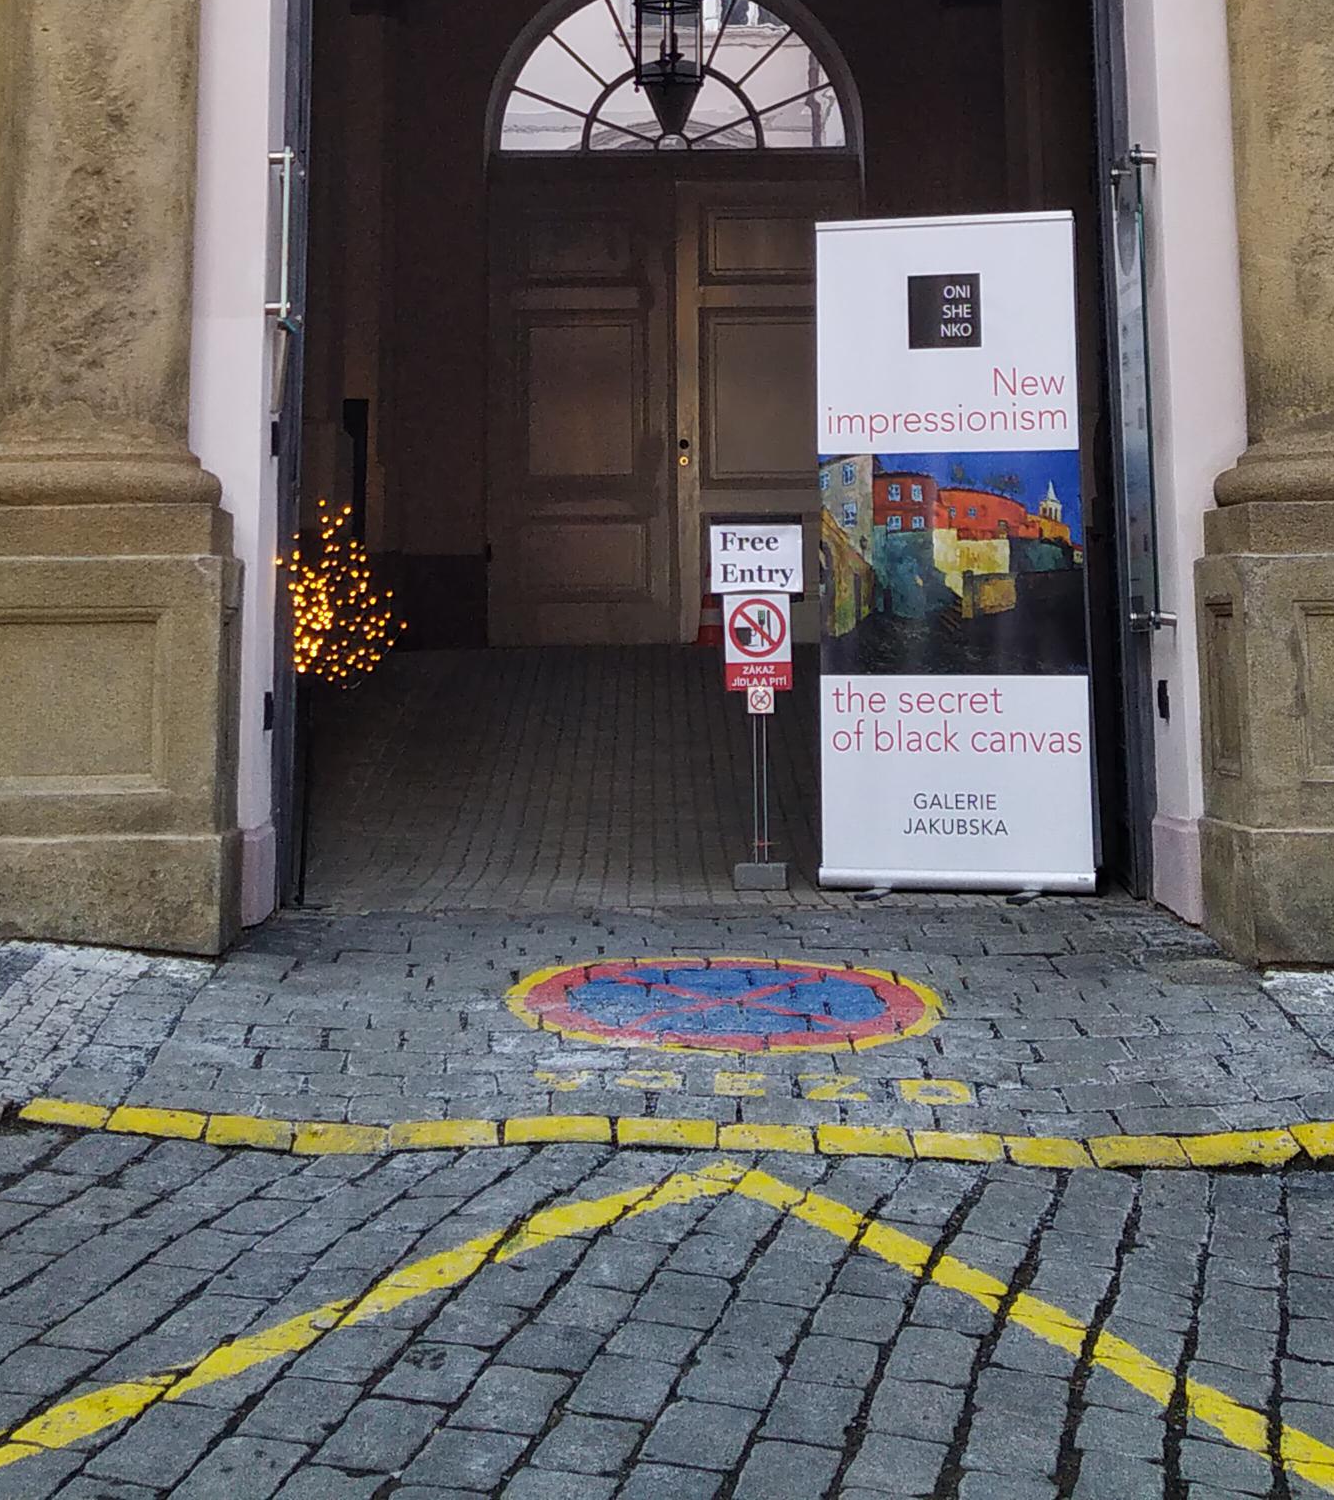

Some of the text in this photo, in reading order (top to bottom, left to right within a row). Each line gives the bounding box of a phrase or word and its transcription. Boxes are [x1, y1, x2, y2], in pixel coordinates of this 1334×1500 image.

[943, 285, 971, 299] ONI
[942, 304, 972, 319] SHE
[940, 323, 972, 337] NKO
[993, 367, 1065, 397] New
[827, 402, 1067, 443] impressionism
[719, 531, 779, 552] Free
[720, 563, 795, 587] Entry
[742, 664, 775, 675] ZÁKAZ
[731, 675, 787, 687] JÍDLA A PITÍ
[832, 681, 1003, 714] the secret
[832, 719, 1083, 753] of black canvas
[913, 793, 997, 811] GALERIE
[903, 818, 1008, 836] JAKUBSKA
